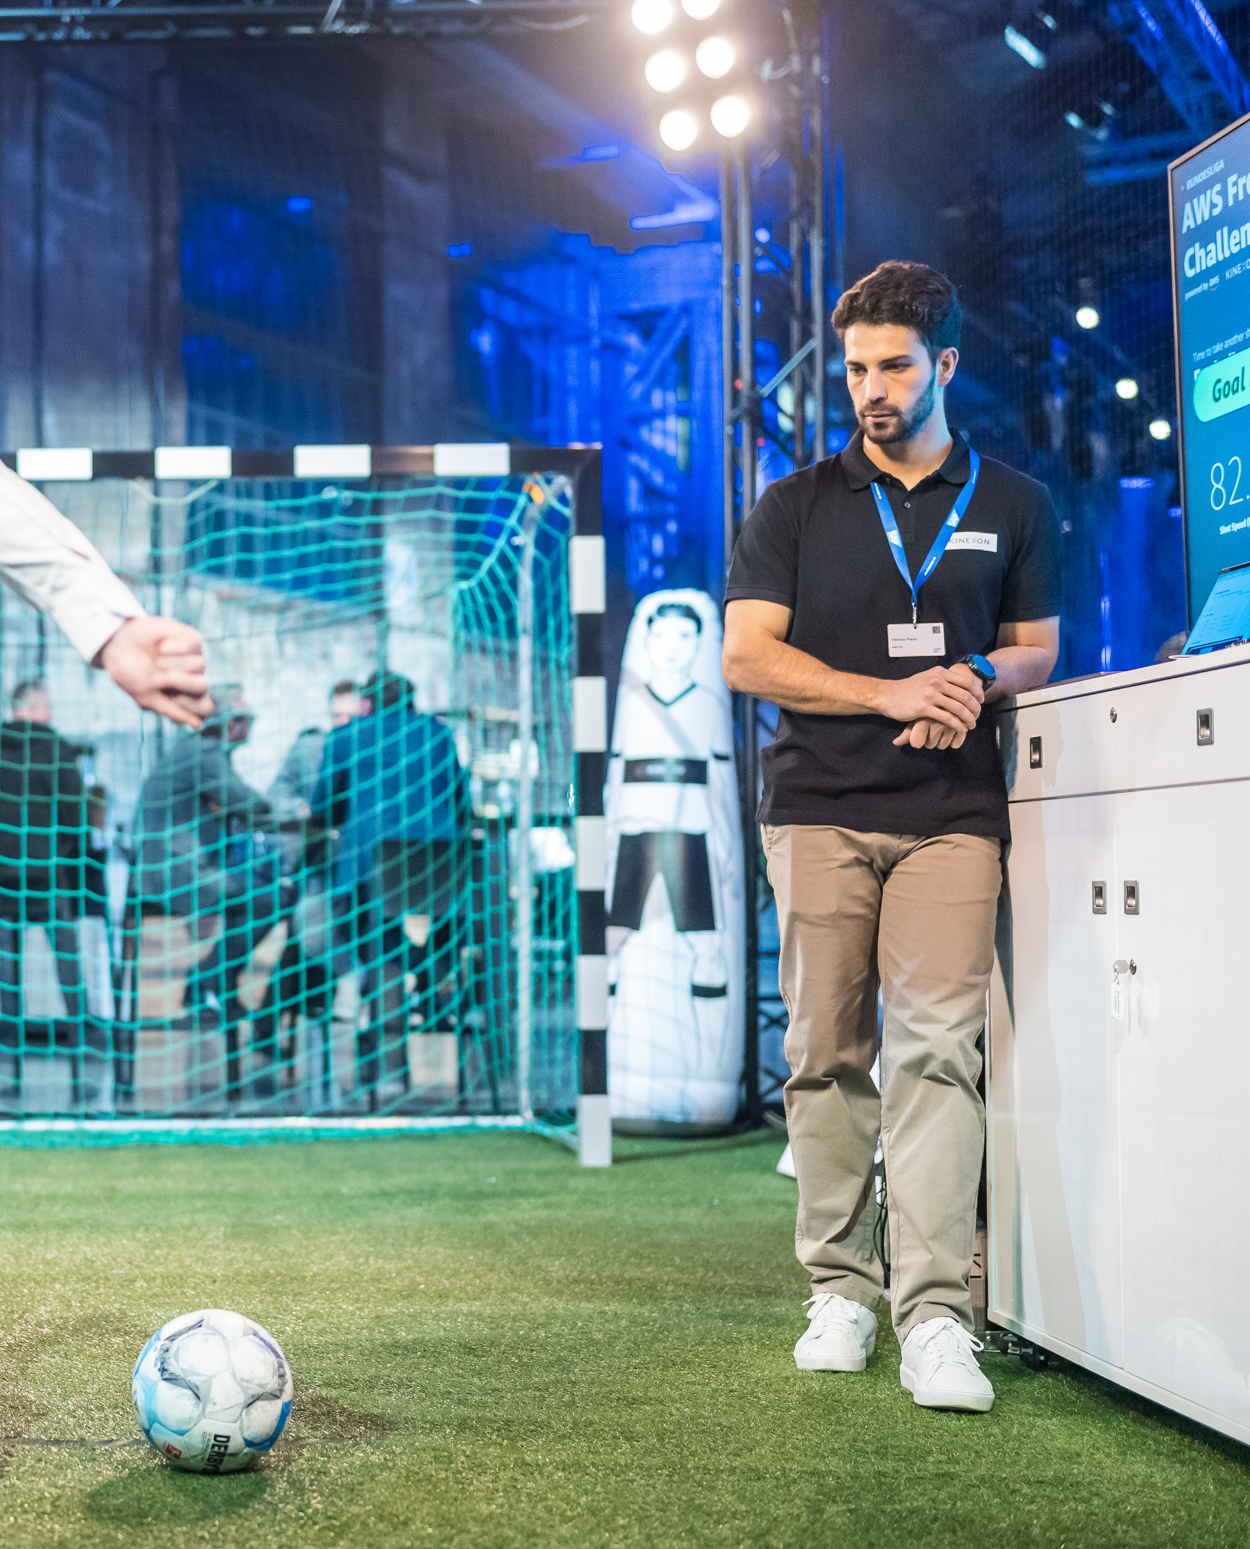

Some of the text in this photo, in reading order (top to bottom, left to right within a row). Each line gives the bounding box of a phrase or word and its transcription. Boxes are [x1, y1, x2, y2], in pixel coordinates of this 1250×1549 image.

[1186, 159, 1225, 191] BUNDESLIGA
[1182, 183, 1224, 234] AWS
[1193, 350, 1206, 362] Time
[1205, 347, 1212, 357] to
[1212, 341, 1224, 354] take
[1224, 331, 1244, 349] another
[1212, 366, 1246, 403] Goal
[949, 537, 990, 545] KINEXON
